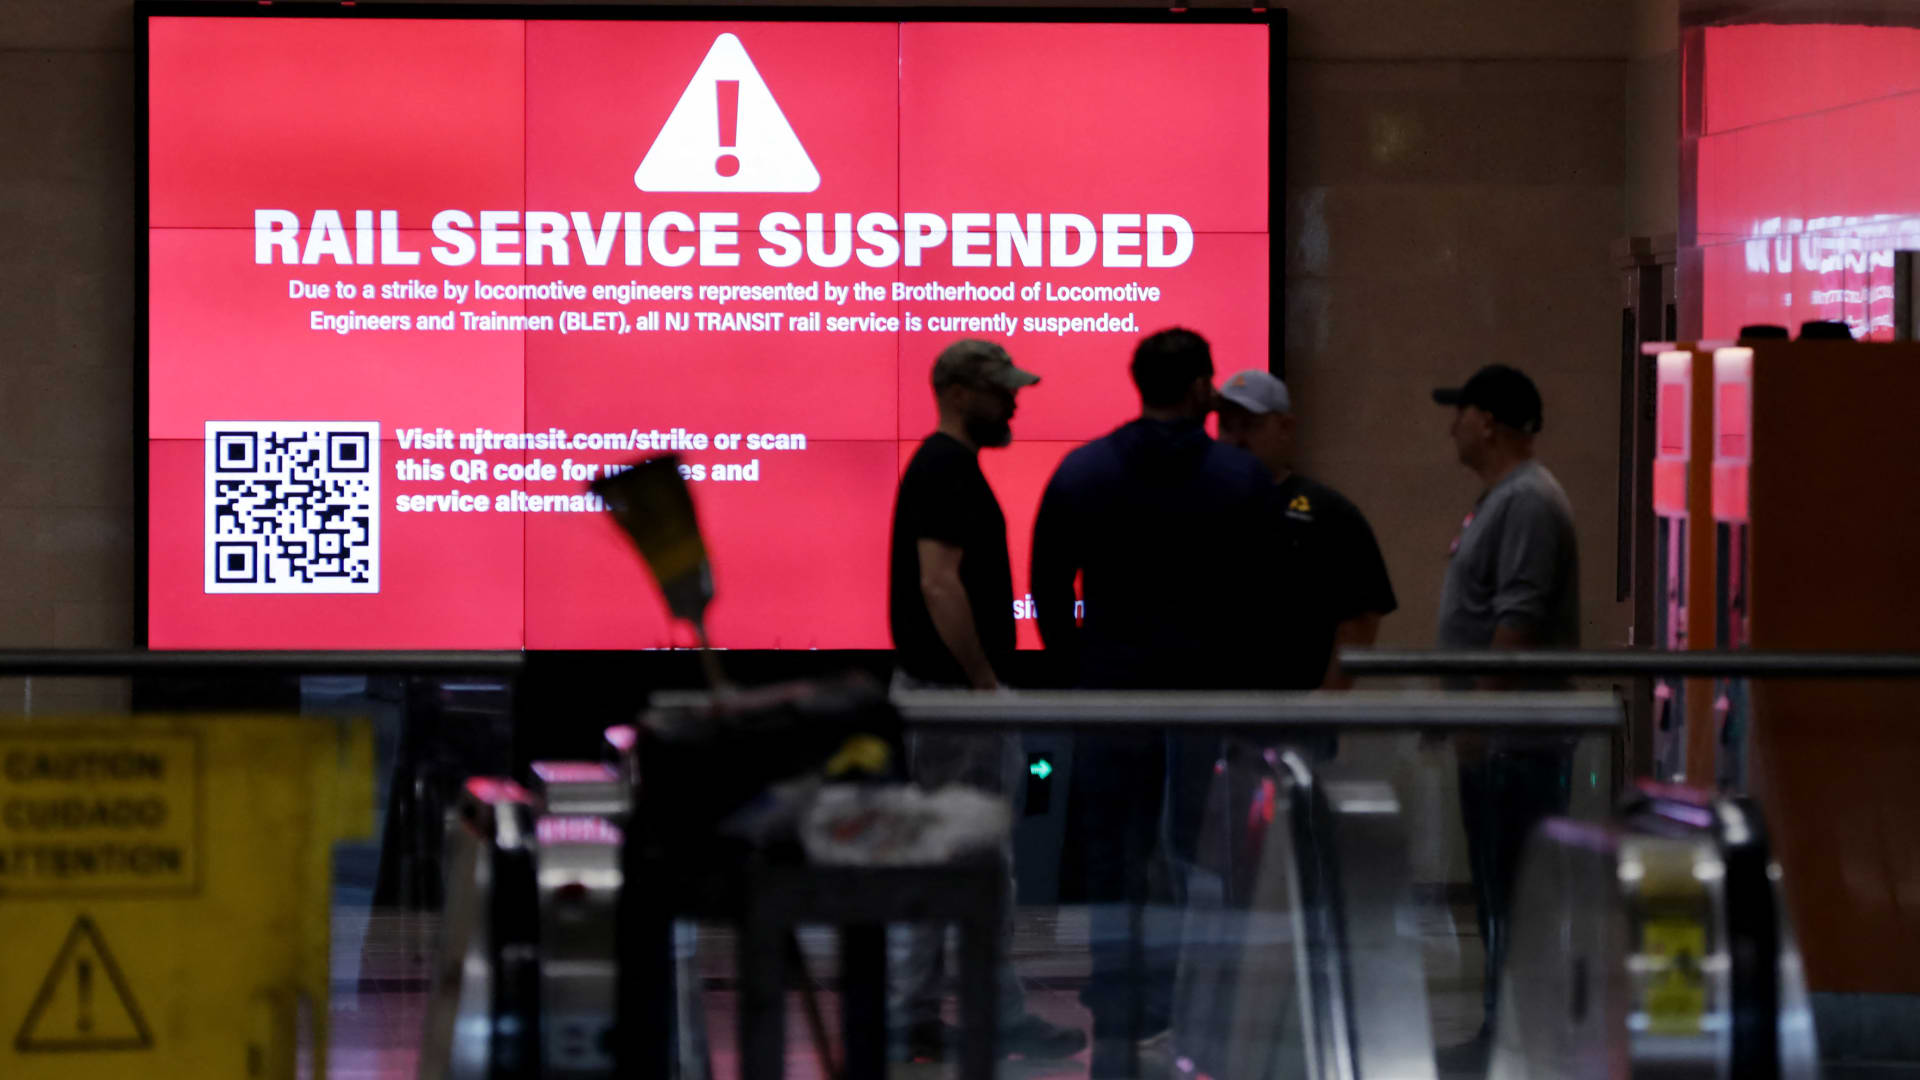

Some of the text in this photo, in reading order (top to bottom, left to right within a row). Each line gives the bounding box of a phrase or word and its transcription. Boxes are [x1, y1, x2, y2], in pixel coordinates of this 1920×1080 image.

[254, 209, 1195, 269] RAIL SERVICE SUSPENDED
[288, 280, 1161, 306] Due to a strike by locomotive engineers represented by the Brotherhood of Locomotive
[310, 310, 1140, 337] Engineers and Trainmen (BLET), all NJ TRANSIT rail service is currently suspended.
[395, 427, 807, 454] Visit njtransit.com/strike or scan
[395, 458, 445, 481] this
[450, 459, 488, 484] QR
[493, 459, 558, 481] code
[562, 459, 599, 481] for
[711, 459, 760, 482] and
[395, 490, 627, 513] service alternati
